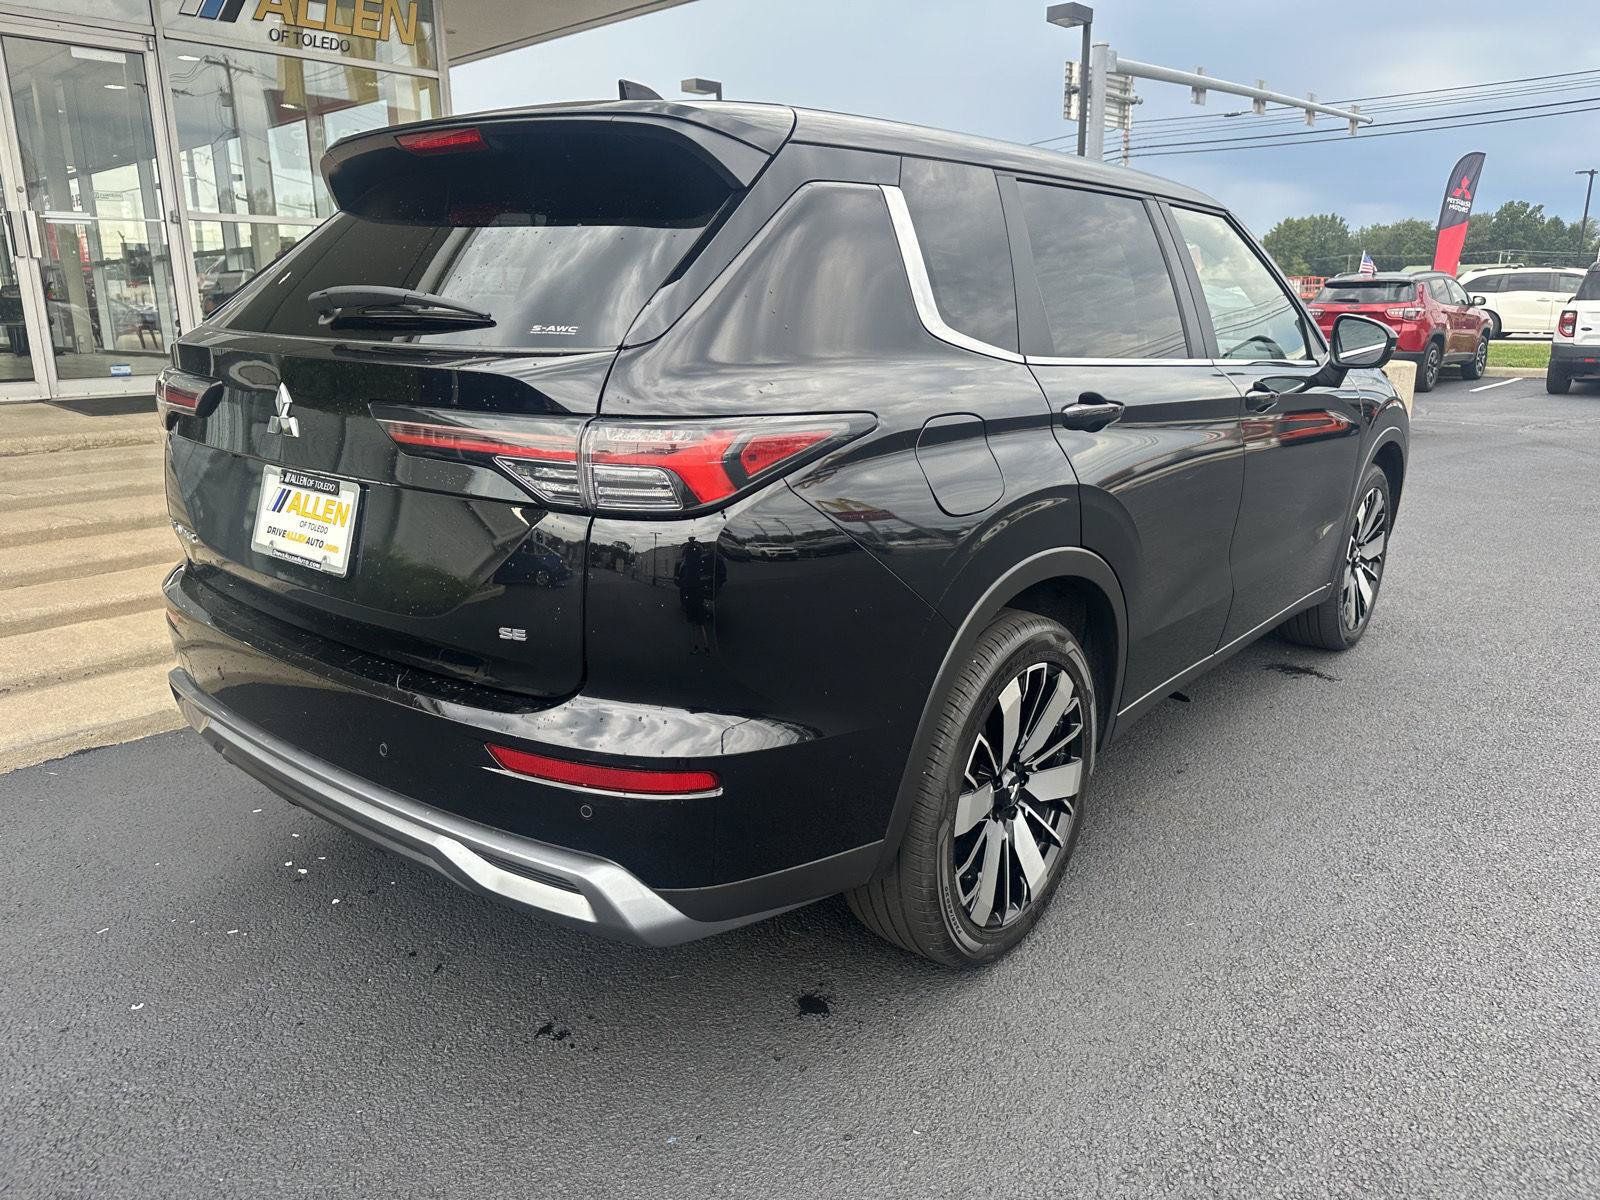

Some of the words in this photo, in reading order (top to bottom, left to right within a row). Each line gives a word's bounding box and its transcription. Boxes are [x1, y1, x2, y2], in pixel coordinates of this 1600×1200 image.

[252, 0, 417, 46] ALLEN
[269, 28, 290, 43] OF
[294, 33, 351, 53] TOLEDO
[531, 324, 579, 333] S-AWC
[290, 473, 308, 485] ALLEN
[315, 480, 336, 492] TOLEDO
[287, 492, 350, 528] ALLEN
[300, 520, 308, 528] OF
[308, 521, 329, 535] TOLEDO
[498, 627, 528, 642] SE
